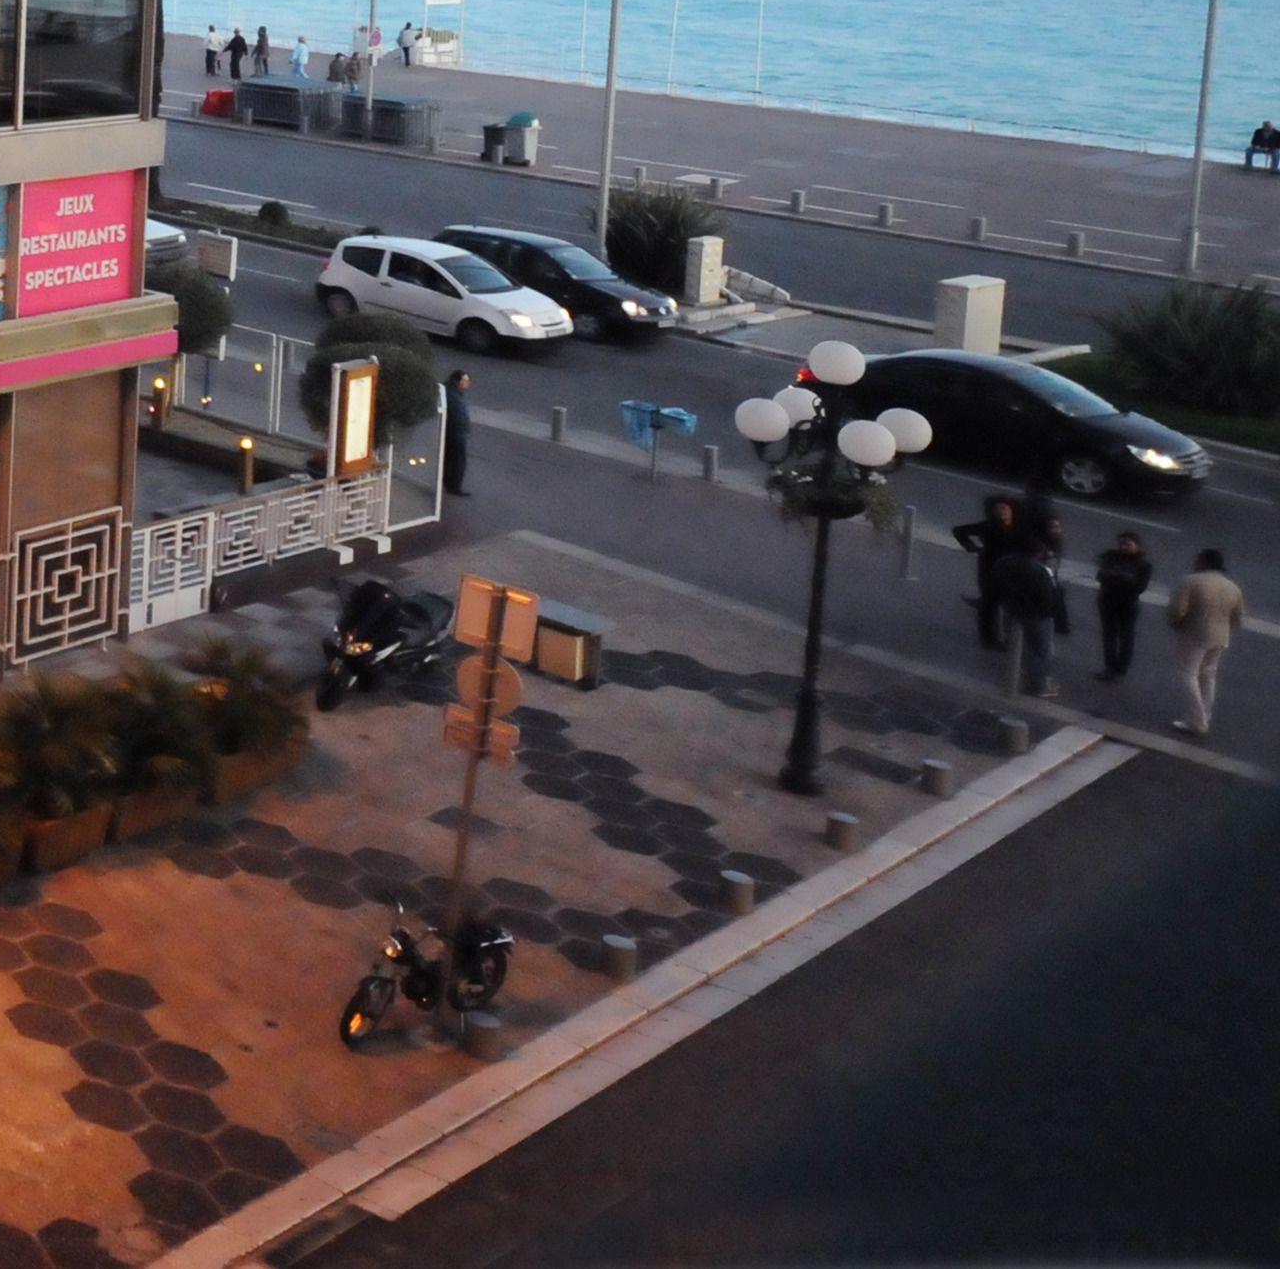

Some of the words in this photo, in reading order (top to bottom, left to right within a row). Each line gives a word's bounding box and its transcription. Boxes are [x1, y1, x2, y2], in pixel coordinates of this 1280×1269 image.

[56, 194, 94, 216] JEUX
[20, 224, 126, 256] RESTAURANTS
[25, 258, 119, 290] SPECTACLES
